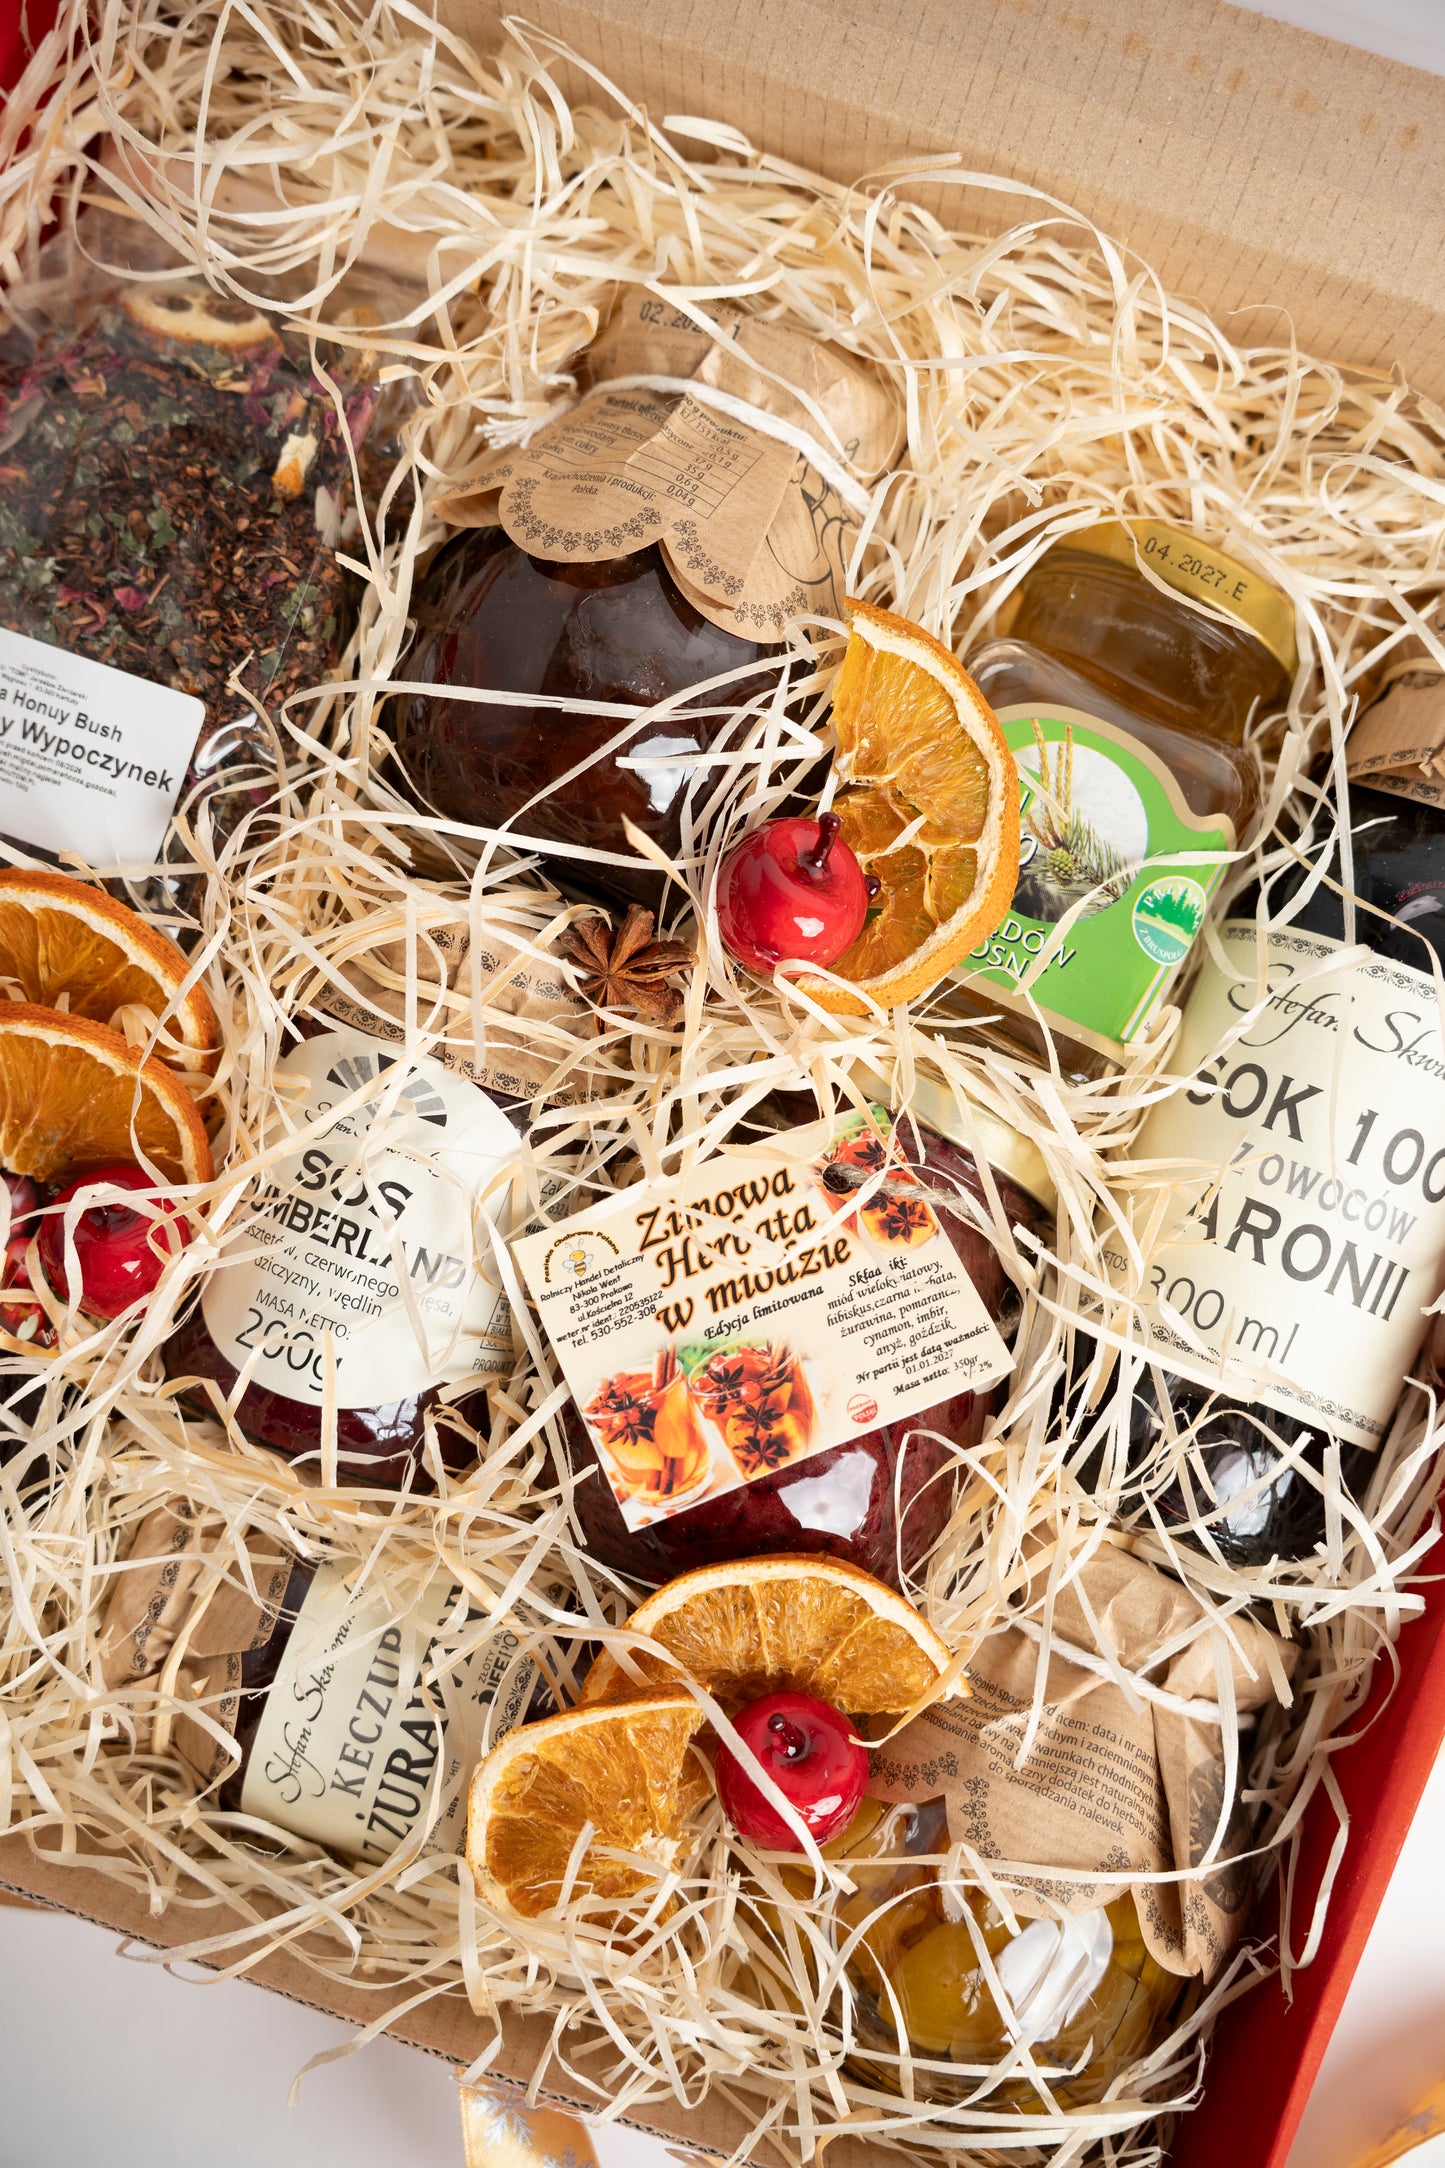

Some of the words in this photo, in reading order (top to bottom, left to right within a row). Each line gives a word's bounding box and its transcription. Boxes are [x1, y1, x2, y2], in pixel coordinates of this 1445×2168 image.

[710, 434, 731, 447] kcal
[611, 477, 657, 502] produkcji:
[675, 472, 692, 488] 0,6
[690, 482, 700, 494] g
[684, 463, 698, 475] 35
[696, 471, 706, 481] g
[665, 483, 690, 502] 0,04
[687, 496, 697, 507] g
[13, 689, 71, 726] Honuy
[74, 711, 122, 743] Bush
[22, 718, 174, 793] Wypoczynek
[989, 918, 1076, 969] DÓW
[1185, 1052, 1324, 1143] SOK
[295, 1150, 414, 1220] SOS
[635, 1166, 796, 1253] Zimowa
[848, 1256, 909, 1288] Składiki:
[1185, 1182, 1411, 1322] ARONII
[304, 1251, 400, 1298] czerwonego
[540, 1285, 574, 1303] Rolniczy
[574, 1270, 603, 1290] Handel
[603, 1253, 646, 1278] Detaliczny
[572, 1286, 599, 1303] Nikola
[599, 1274, 622, 1290] Went
[255, 1289, 295, 1318] MASA
[299, 1307, 352, 1341] NETTO:
[569, 1295, 600, 1315] 83-300
[600, 1282, 634, 1302] Prokowo
[618, 1289, 665, 1318] 220535122
[623, 1291, 635, 1304] 12
[655, 1295, 697, 1335] w
[703, 1315, 751, 1341] Edycja
[752, 1285, 825, 1320] limitowana
[827, 1290, 855, 1310] miód
[1150, 1265, 1225, 1330] 300
[1236, 1316, 1300, 1364] ml
[571, 1335, 590, 1349] tel.
[590, 1303, 658, 1342] 530-552-308
[840, 1313, 897, 1338] żurawina,
[863, 1322, 915, 1348] cynamon,
[916, 1305, 949, 1324] imbir,
[855, 1370, 871, 1384] Nr
[872, 1360, 900, 1381] partii
[900, 1352, 919, 1369] jest
[920, 1343, 943, 1358] datą
[943, 1322, 991, 1348] ważności:
[876, 1340, 907, 1358] anyż,
[904, 1348, 955, 1376] 01.01.2027
[892, 1378, 922, 1397] Masa
[922, 1367, 951, 1384] netto:
[953, 1354, 980, 1371] 350gr
[478, 1648, 496, 1684] ZŁOTY
[331, 1626, 402, 1800] KECZUP
[1092, 1723, 1117, 1743] data
[1124, 1739, 1136, 1753] nr
[449, 1759, 461, 1777] HIT
[918, 1710, 980, 1746] astosowanie:
[1048, 1774, 1095, 1802] dodatek
[1095, 1796, 1111, 1811] do
[1111, 1802, 1148, 1838] herbaty,
[968, 1715, 1001, 1742] barwy
[1000, 1736, 1015, 1752] na
[1077, 1771, 1100, 1789] jest
[1101, 1782, 1147, 1820] naturalną
[1035, 1742, 1096, 1770] warunkach
[1097, 1761, 1154, 1809] chłodniczych
[1086, 1740, 1155, 1788] zaciemnionym
[988, 1761, 1004, 1776] do
[1003, 1773, 1077, 1812] sporządzania
[1078, 1804, 1125, 1837] nalewek.
